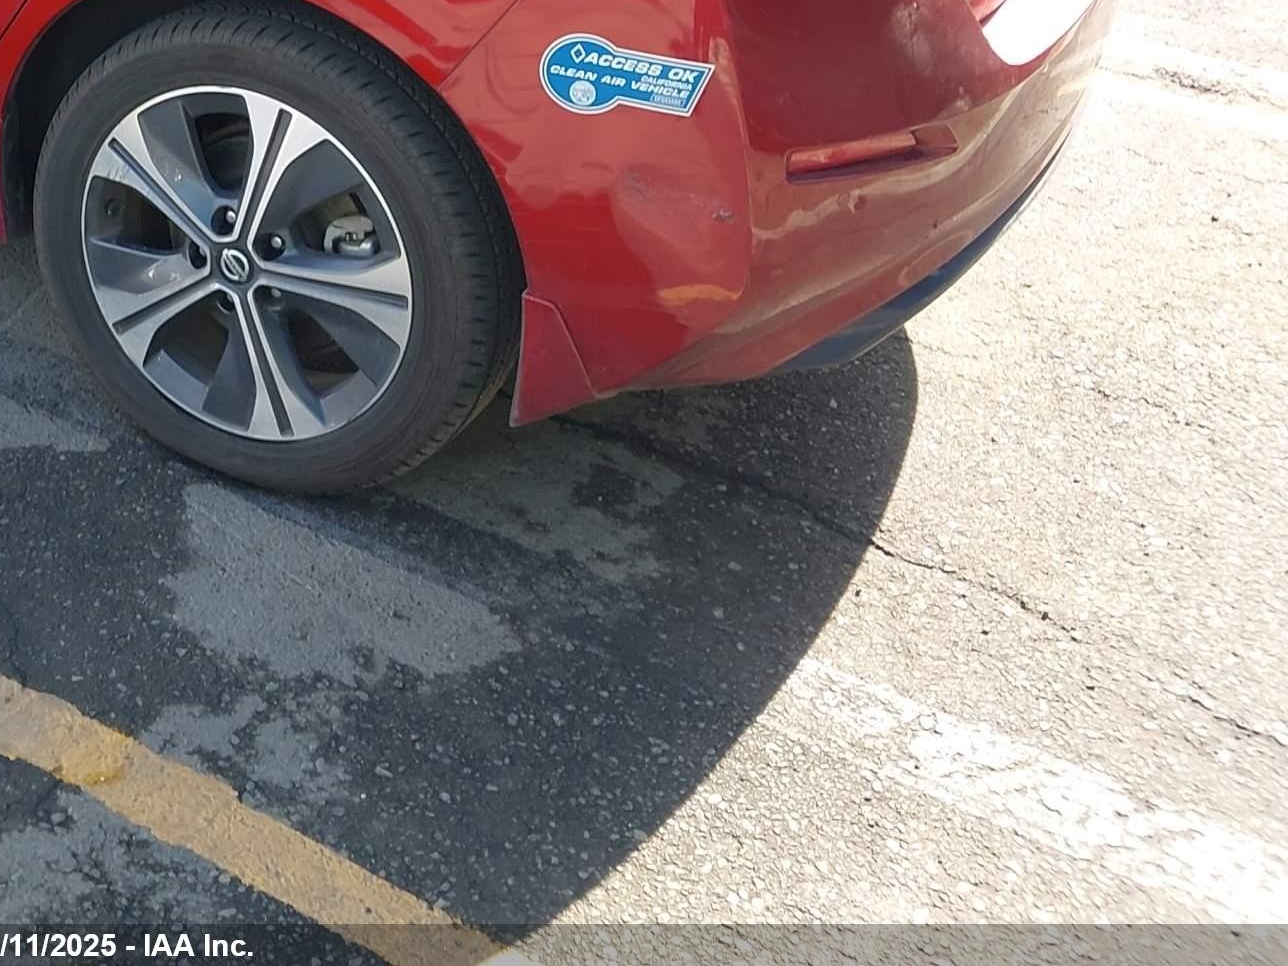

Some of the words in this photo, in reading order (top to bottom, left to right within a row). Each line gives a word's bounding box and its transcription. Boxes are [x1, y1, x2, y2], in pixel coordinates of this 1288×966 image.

[550, 65, 598, 81] CLEAN
[600, 76, 627, 87] AIR
[631, 81, 690, 99] VEHICLE
[584, 51, 663, 76] ACCESS
[667, 67, 700, 83] OK
[641, 74, 693, 91] CALIFORNIA
